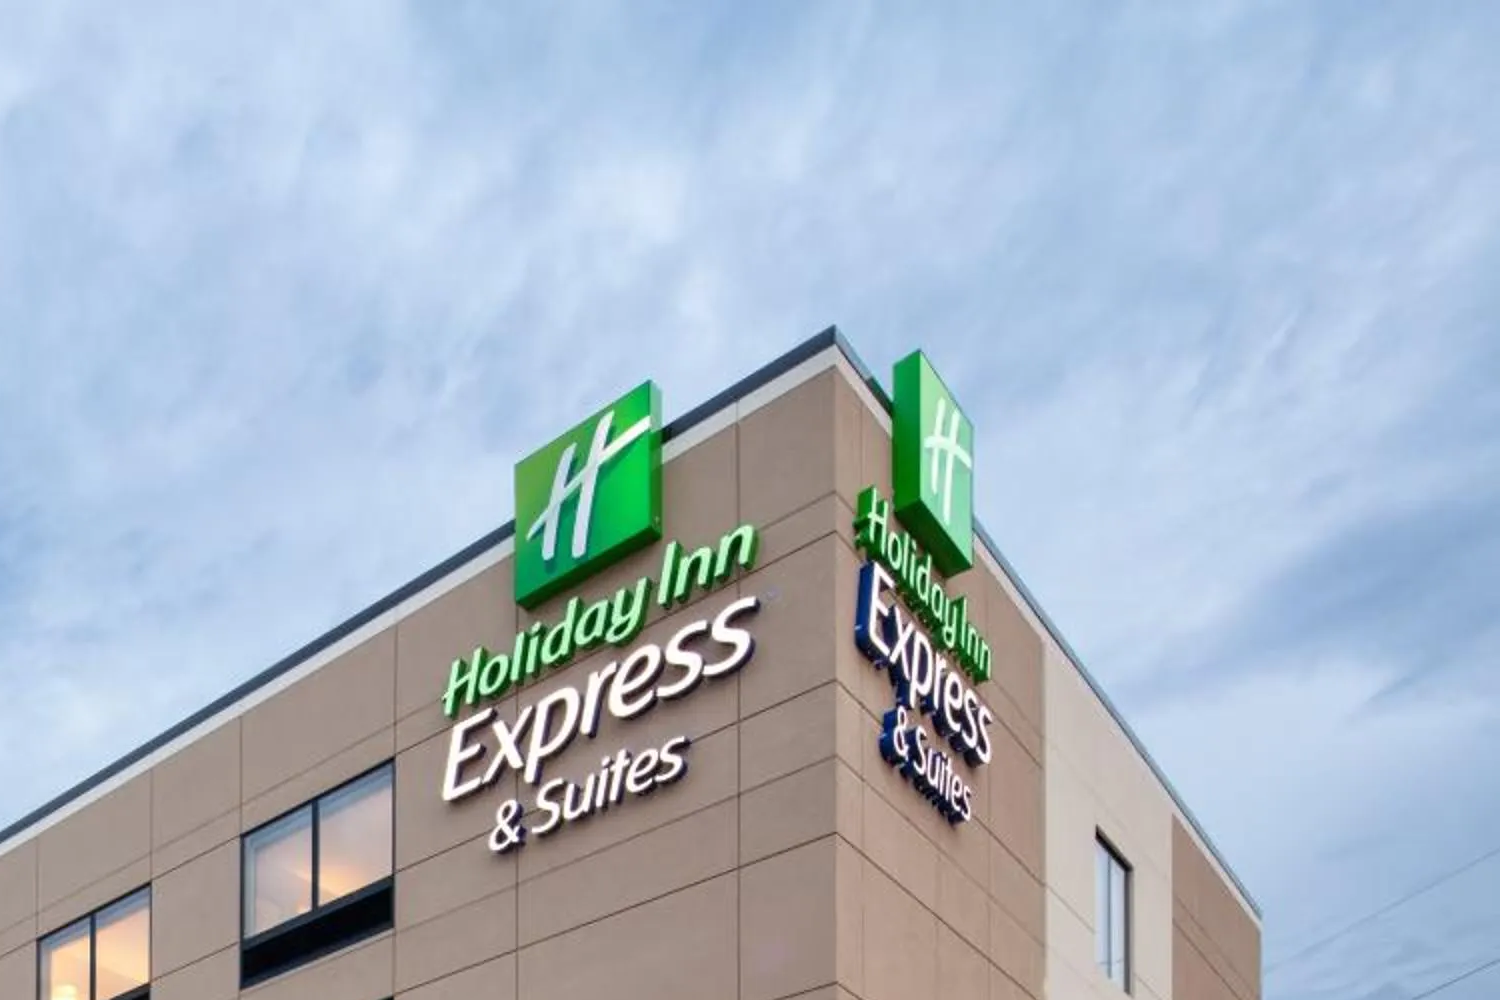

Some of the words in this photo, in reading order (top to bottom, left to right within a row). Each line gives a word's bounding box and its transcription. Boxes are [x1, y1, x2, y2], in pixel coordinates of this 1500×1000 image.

[526, 410, 650, 561] H
[923, 396, 972, 524] H
[442, 576, 650, 716] Holiday
[658, 523, 760, 606] Inn
[862, 486, 958, 646] Holiday
[957, 593, 992, 682] Inn
[864, 561, 994, 766] Express
[442, 595, 762, 805] Express
[888, 705, 911, 760] &
[911, 725, 972, 823] Suites
[488, 798, 525, 852] &
[530, 735, 691, 837] Suites
